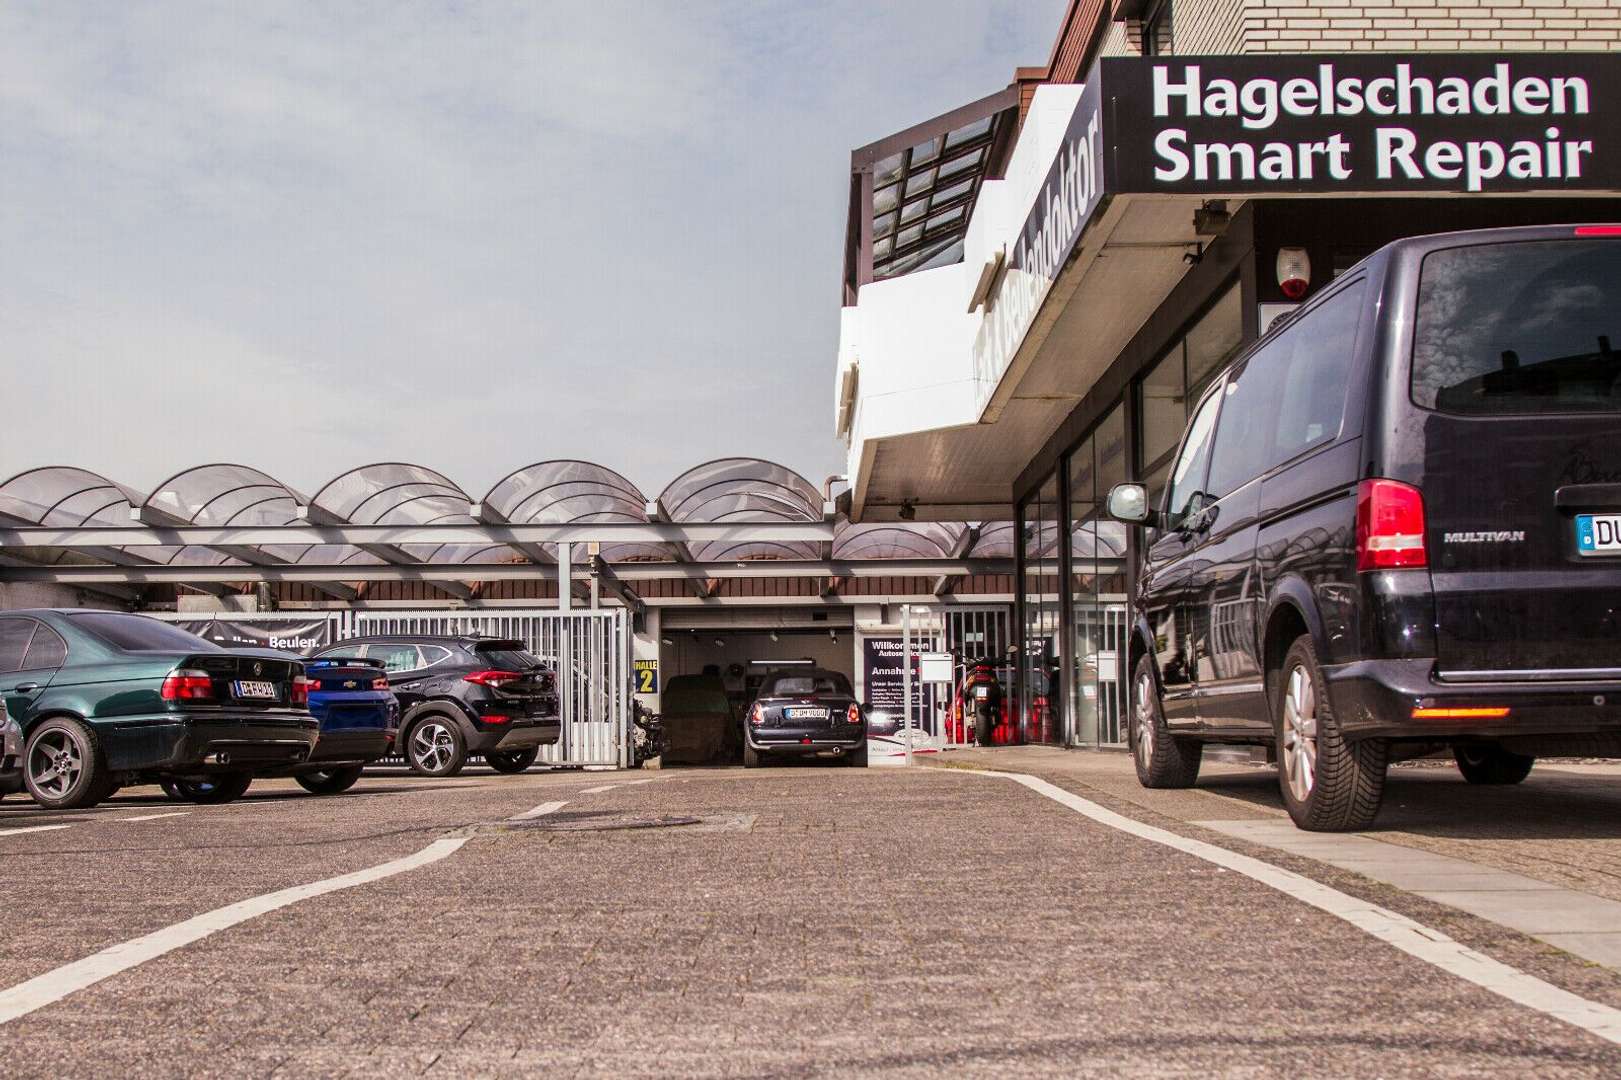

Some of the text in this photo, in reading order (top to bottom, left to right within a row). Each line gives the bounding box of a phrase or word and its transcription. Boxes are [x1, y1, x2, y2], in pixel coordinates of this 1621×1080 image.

[1152, 63, 1589, 128] Hagelschaden
[1154, 126, 1593, 191] Smart Repair
[1444, 531, 1525, 543] MULTIVAN
[269, 636, 320, 649] Beulen.
[635, 660, 657, 670] HALLE
[640, 669, 653, 693] 2
